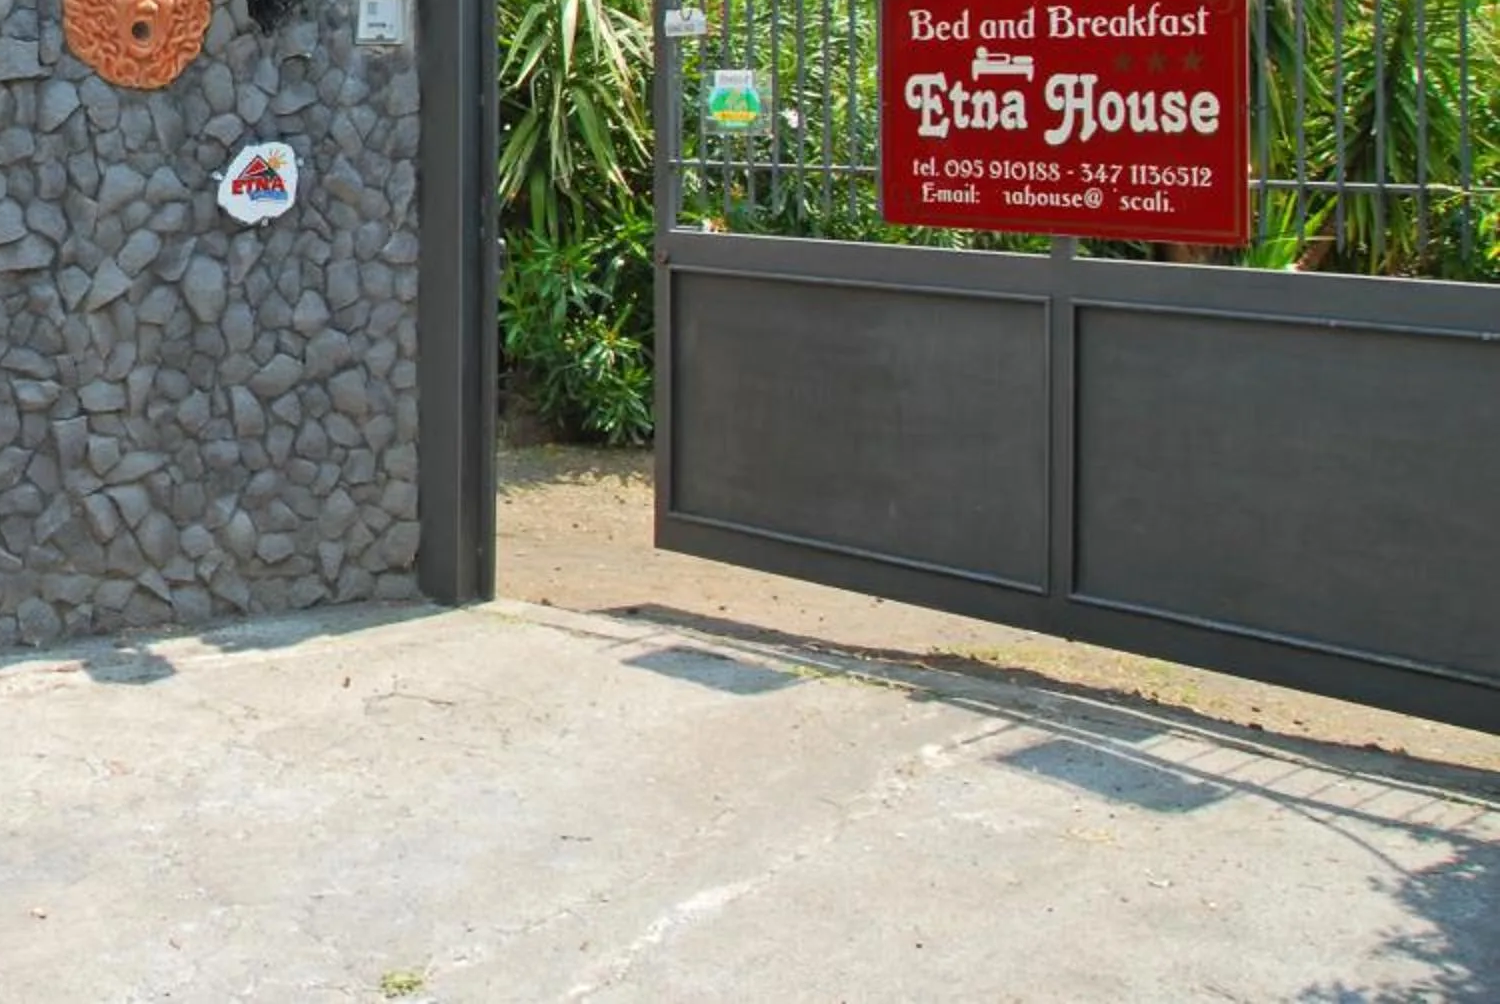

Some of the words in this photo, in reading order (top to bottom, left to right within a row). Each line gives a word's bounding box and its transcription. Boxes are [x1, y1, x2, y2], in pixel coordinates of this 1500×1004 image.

[908, 8, 970, 41] Bed
[979, 7, 1036, 40] and
[1047, 2, 1210, 39] Breakfast
[904, 71, 1028, 139] Etna
[1043, 73, 1220, 146] House
[231, 175, 285, 195] ETNA
[912, 156, 940, 177] tel.
[944, 159, 985, 178] 095
[989, 160, 1061, 181] 910188
[1080, 162, 1124, 184] 347
[1129, 163, 1213, 187] 1136512
